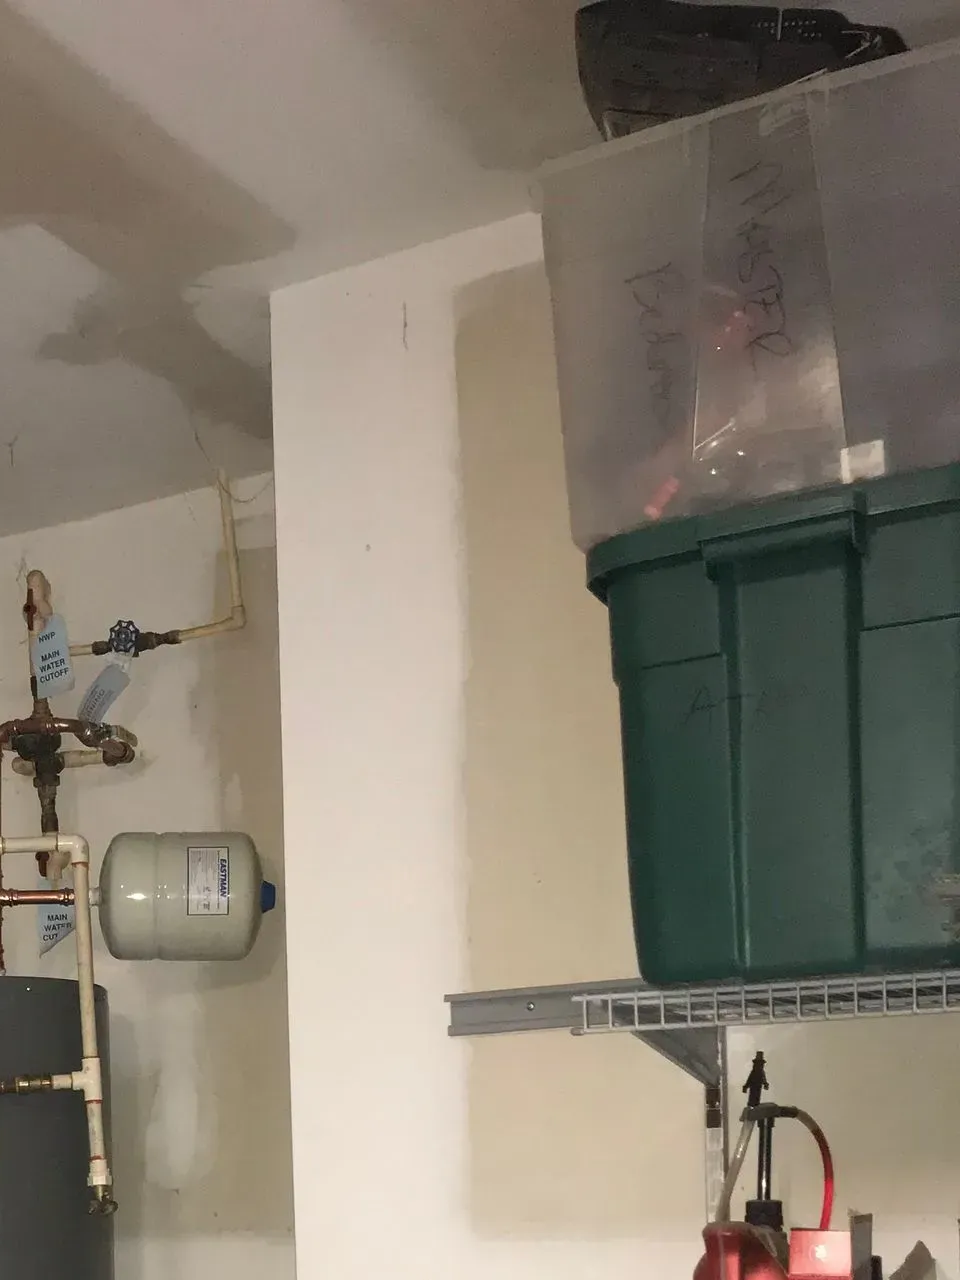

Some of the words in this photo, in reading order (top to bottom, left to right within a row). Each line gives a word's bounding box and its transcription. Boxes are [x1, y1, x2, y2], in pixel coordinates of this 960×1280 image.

[38, 631, 56, 644] NWP
[41, 650, 60, 662] MAIN
[40, 658, 66, 673] WATER
[40, 667, 69, 684] CUTOFF
[219, 858, 228, 898] EASTMAN
